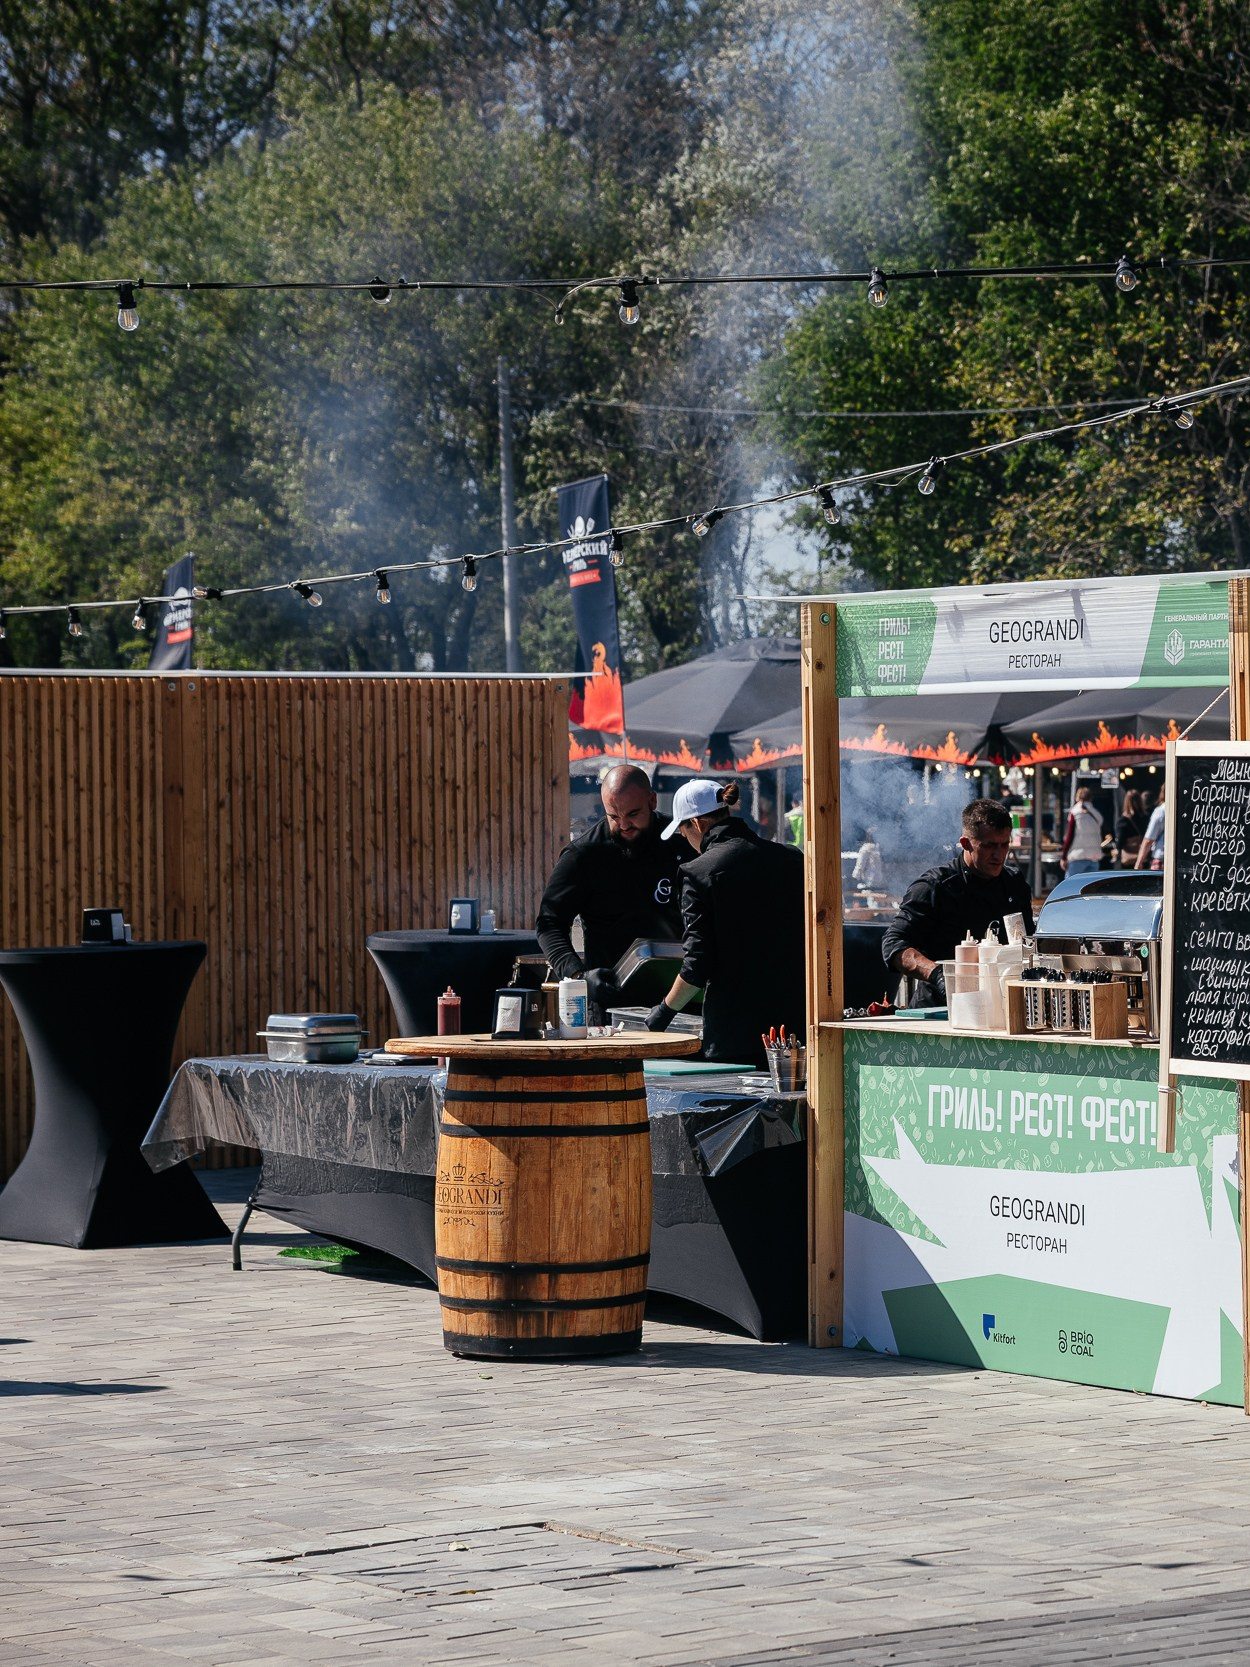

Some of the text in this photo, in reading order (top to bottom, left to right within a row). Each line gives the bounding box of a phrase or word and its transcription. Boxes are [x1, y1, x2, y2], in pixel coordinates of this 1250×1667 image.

[878, 617, 911, 637] ГРИЛЬ!
[1164, 612, 1228, 622] ГЕНЕРАЛЬНЫЙ ПАРТН
[989, 618, 1084, 644] GEOGRANDI
[878, 640, 904, 660] РЕСТ!
[1189, 639, 1228, 649] ГАРАНТИ
[1008, 652, 1061, 669] РЕСТОРАН
[878, 663, 906, 683] ФЕСТ!
[928, 1084, 1157, 1146] ГРИЛЬ! РЕСТ! ФЕСТ!
[437, 1187, 502, 1205] EOGRANDI
[989, 1195, 1086, 1226] GEOGRANDI
[1006, 1232, 1067, 1254] РЕСТОРАН
[993, 1331, 1016, 1345] Kitfort
[1070, 1344, 1094, 1358] COAL
